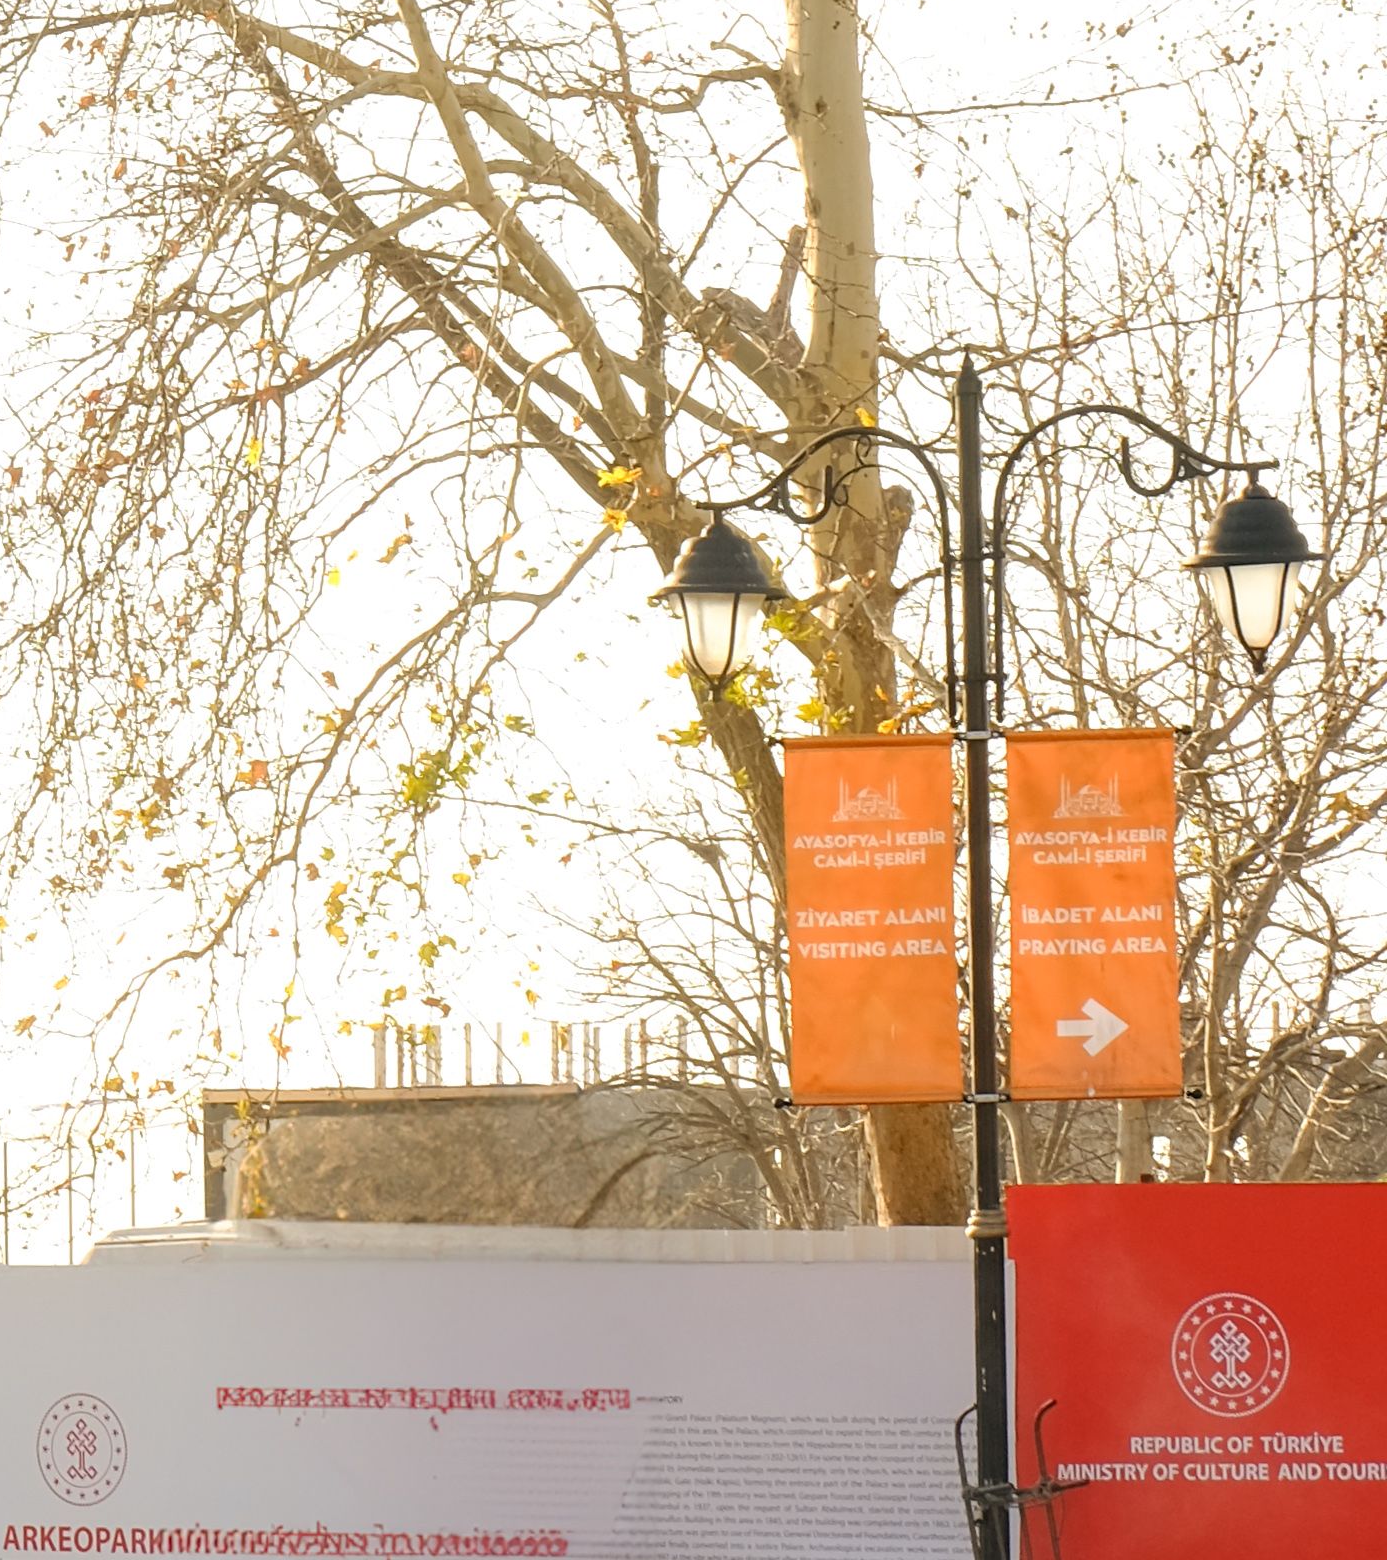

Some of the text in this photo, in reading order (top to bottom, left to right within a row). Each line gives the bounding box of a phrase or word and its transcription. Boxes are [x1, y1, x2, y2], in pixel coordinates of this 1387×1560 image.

[793, 827, 946, 849] AYASOFYA-İ KEBİR
[1015, 825, 1167, 846] AYASOFYA-İ KEBİR
[813, 847, 926, 870] CAMİ-İ ŞERİFİ
[1033, 844, 1147, 868] CAMİ-İ ŞERİFİ
[796, 907, 946, 928] ZİYARET ALANI
[1021, 904, 1162, 925] İBADET ALANI
[798, 938, 947, 959] VISITING AREA
[1019, 936, 1167, 956] PRAYING AREA
[1130, 1431, 1344, 1454] REPUBLIC OF TÜRKİYE
[1057, 1463, 1148, 1481] MINISTRY
[1152, 1463, 1180, 1481] OF
[1183, 1463, 1269, 1481] CULTURE
[1278, 1463, 1322, 1481] AND
